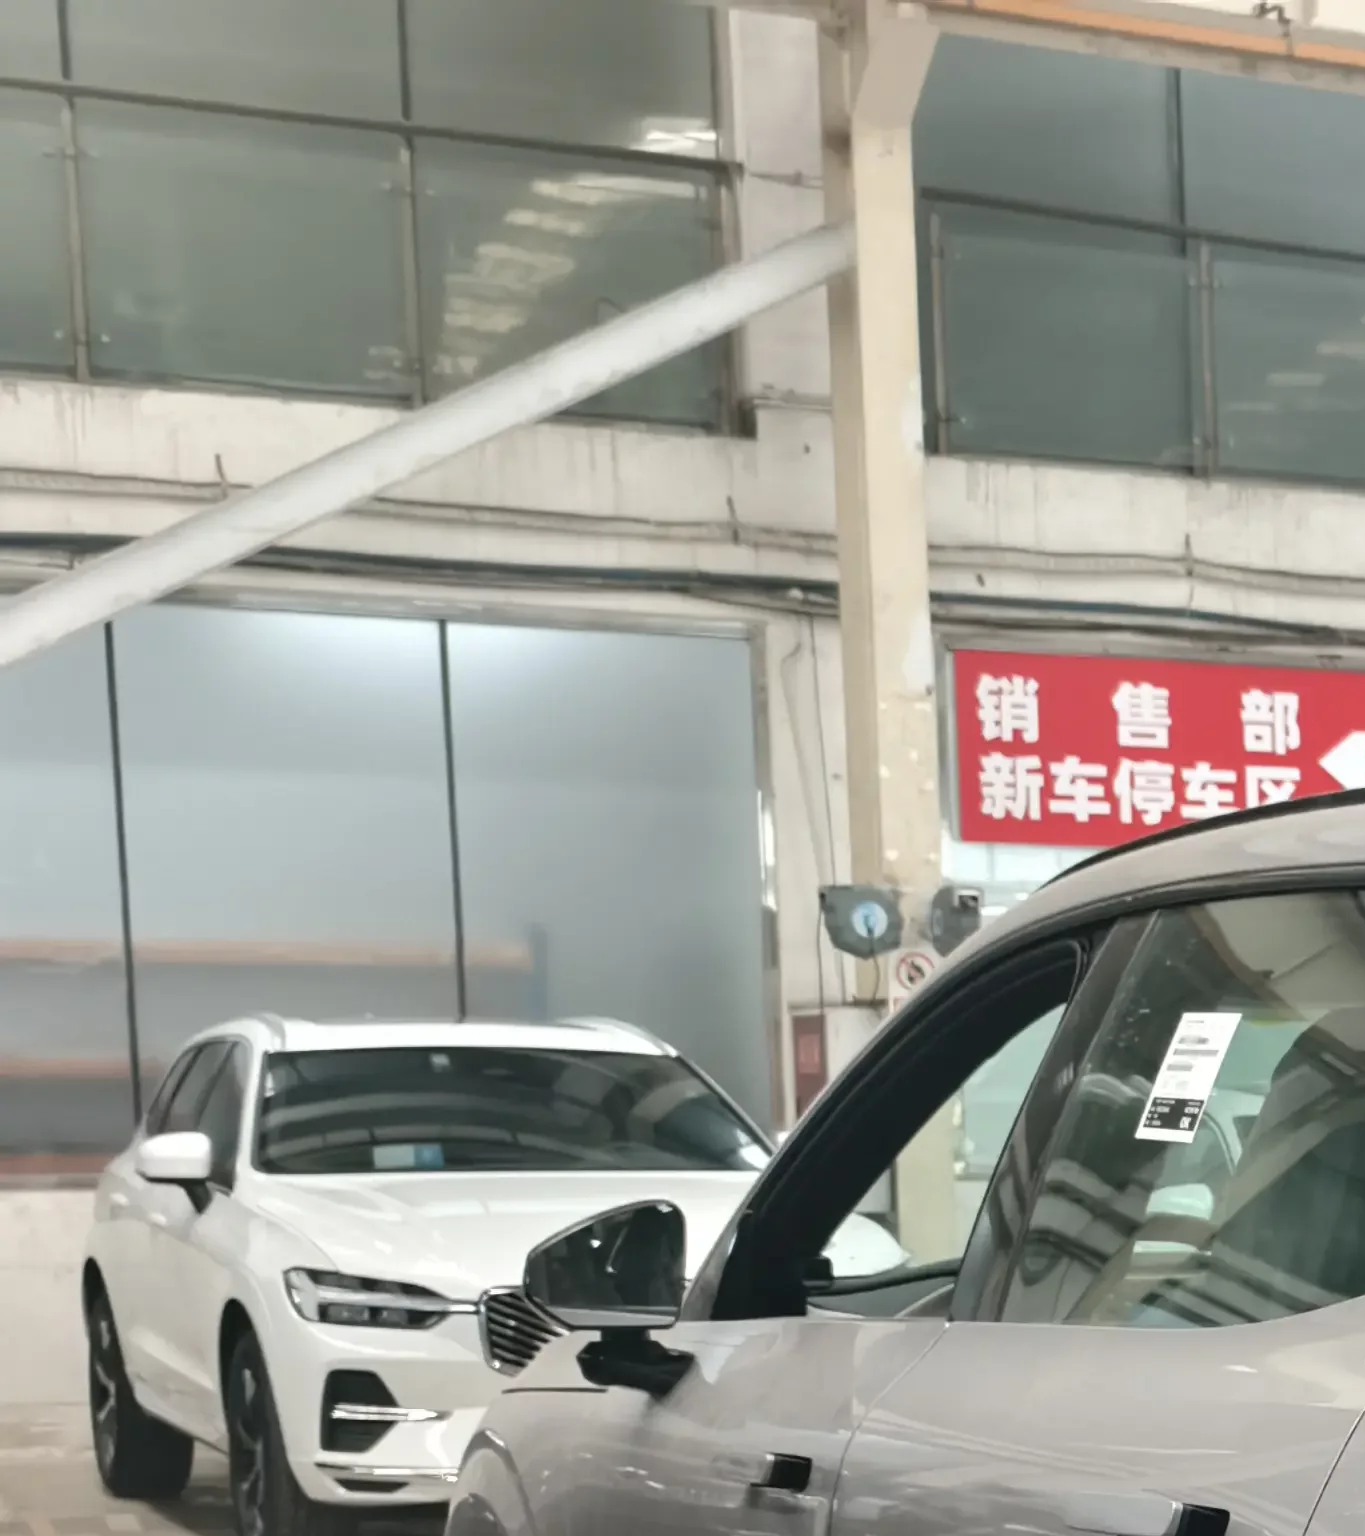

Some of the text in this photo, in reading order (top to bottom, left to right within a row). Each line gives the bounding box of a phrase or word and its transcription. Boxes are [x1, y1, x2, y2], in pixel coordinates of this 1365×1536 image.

[974, 673, 1301, 756] 销售部
[978, 752, 1302, 825] 新车停车区
